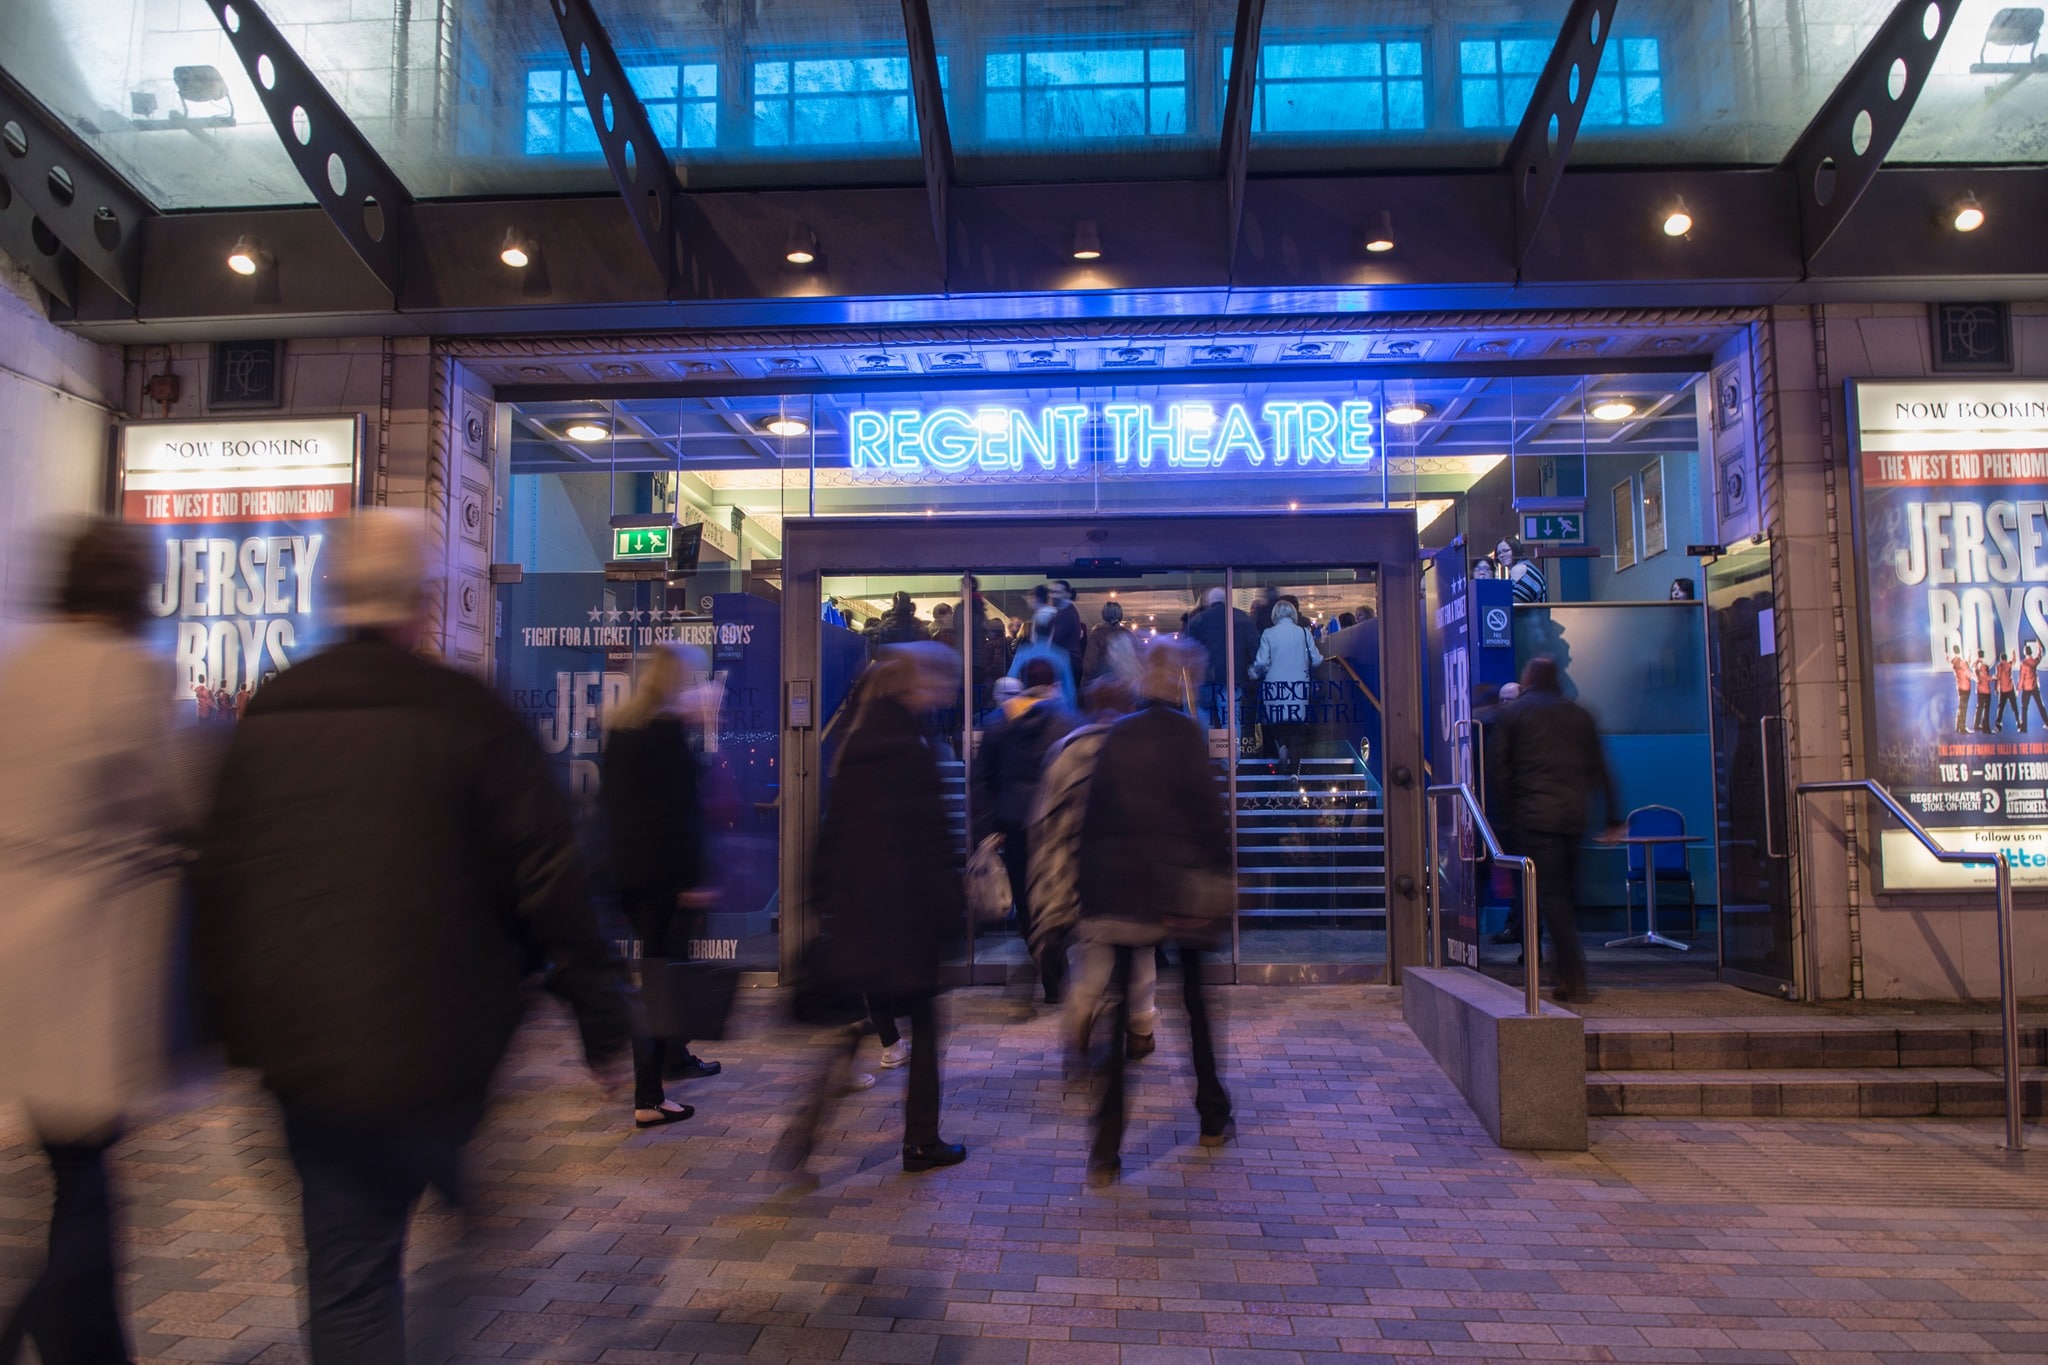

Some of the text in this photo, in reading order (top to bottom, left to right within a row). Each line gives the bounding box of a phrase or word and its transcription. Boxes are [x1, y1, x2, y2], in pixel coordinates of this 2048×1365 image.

[1896, 402, 2048, 419] NOW BOOKIN
[849, 400, 1375, 472] REGENT THEATRE
[165, 438, 318, 458] NOW BOOKING
[1878, 455, 1906, 481] THE
[1908, 455, 1948, 480] WEST
[1951, 454, 1980, 479] END
[144, 489, 334, 518] THE WEST END PHENOMENON
[1895, 500, 2048, 586] JERSE
[149, 535, 322, 617] JERSEY
[559, 626, 582, 646] FOR
[583, 627, 591, 646] A
[593, 626, 632, 646] TICKET
[638, 626, 652, 646] TO
[655, 625, 675, 646] SEE
[677, 625, 718, 646] JERSEY
[539, 671, 728, 754] JERY
[1939, 763, 1960, 782] TUE
[1960, 763, 1968, 782] 6
[1984, 763, 2003, 781] SAT
[2004, 763, 2017, 781] 17
[1910, 791, 1981, 804] REGENT THEATRE
[1922, 801, 1981, 813] STOKE-ON-TRENT
[1975, 831, 2042, 843] Follow us on
[687, 939, 738, 960] EBRUARY
